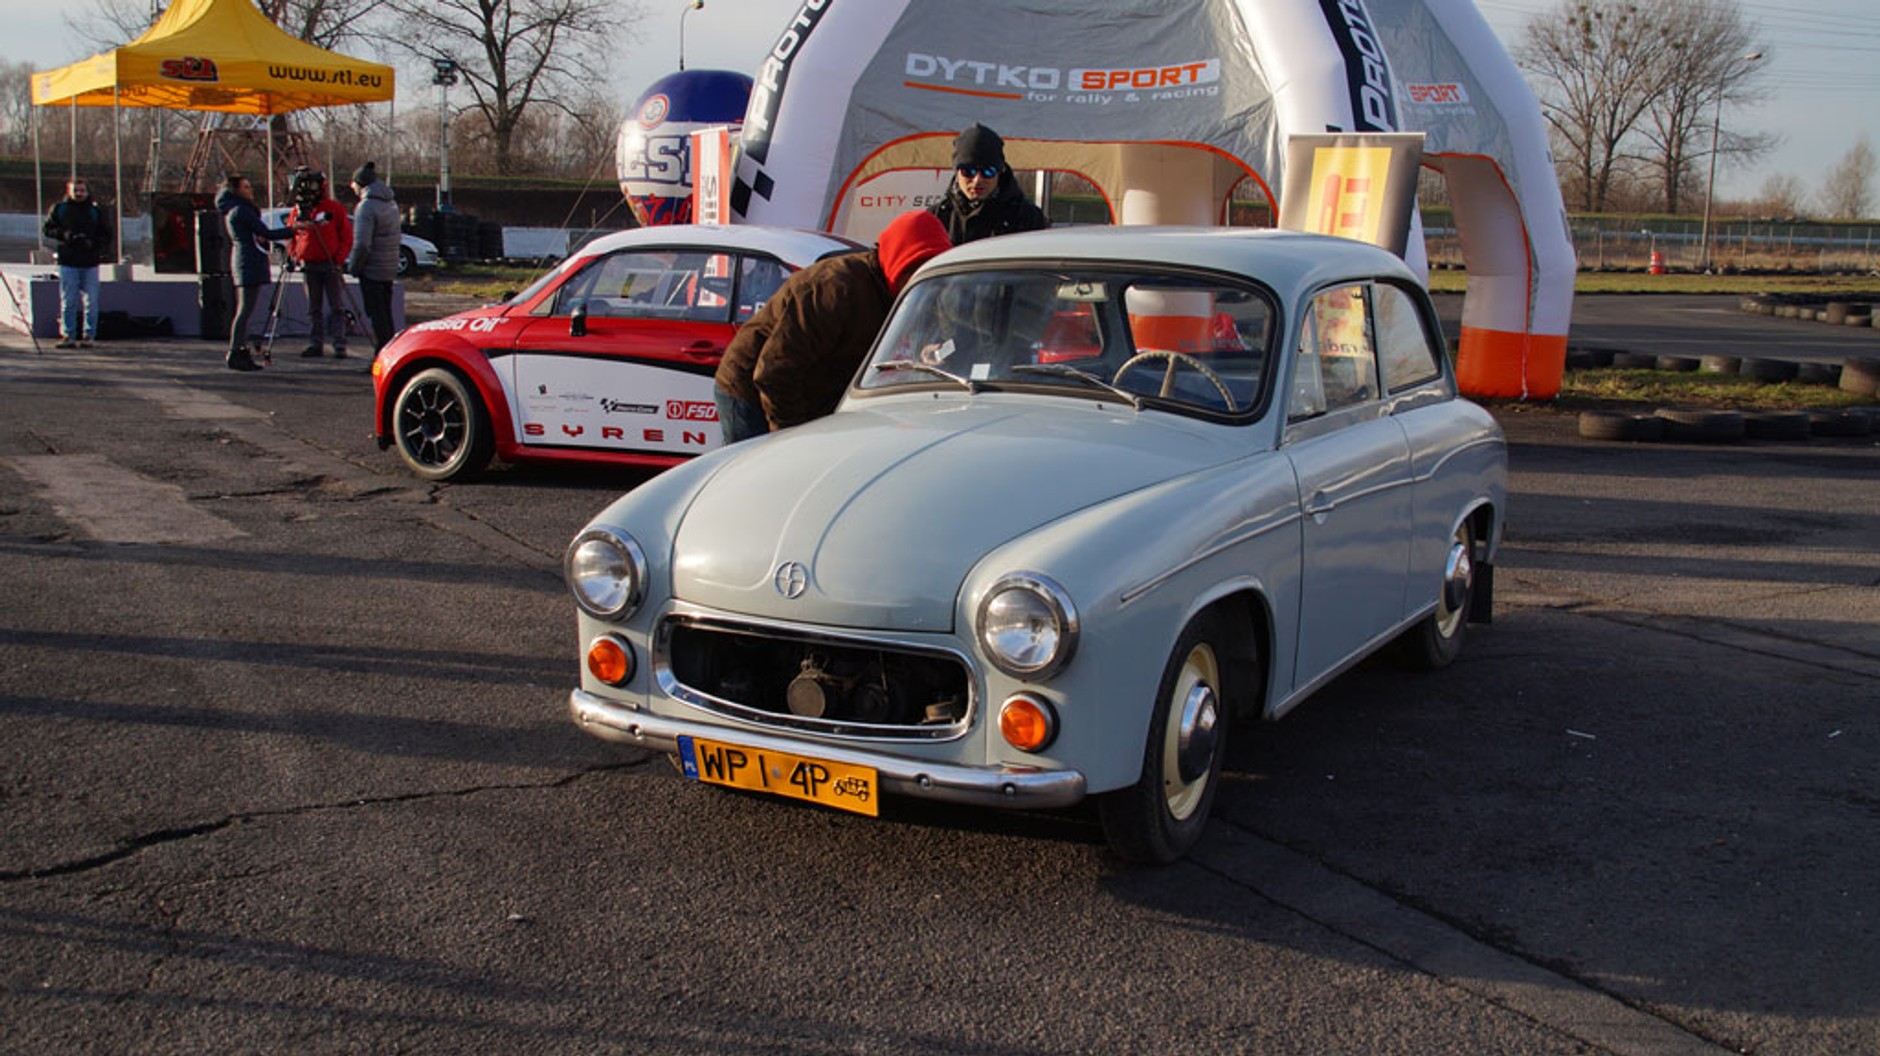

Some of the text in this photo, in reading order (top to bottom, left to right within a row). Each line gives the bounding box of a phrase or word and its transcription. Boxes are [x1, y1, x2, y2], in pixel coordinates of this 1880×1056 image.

[905, 52, 1207, 89] DYTKO SPORT
[1337, 0, 1395, 131] PROT
[1027, 85, 1219, 105] for rally & racing
[1408, 84, 1461, 102] SPORT
[861, 196, 906, 207] CITY
[687, 404, 718, 420] FSO
